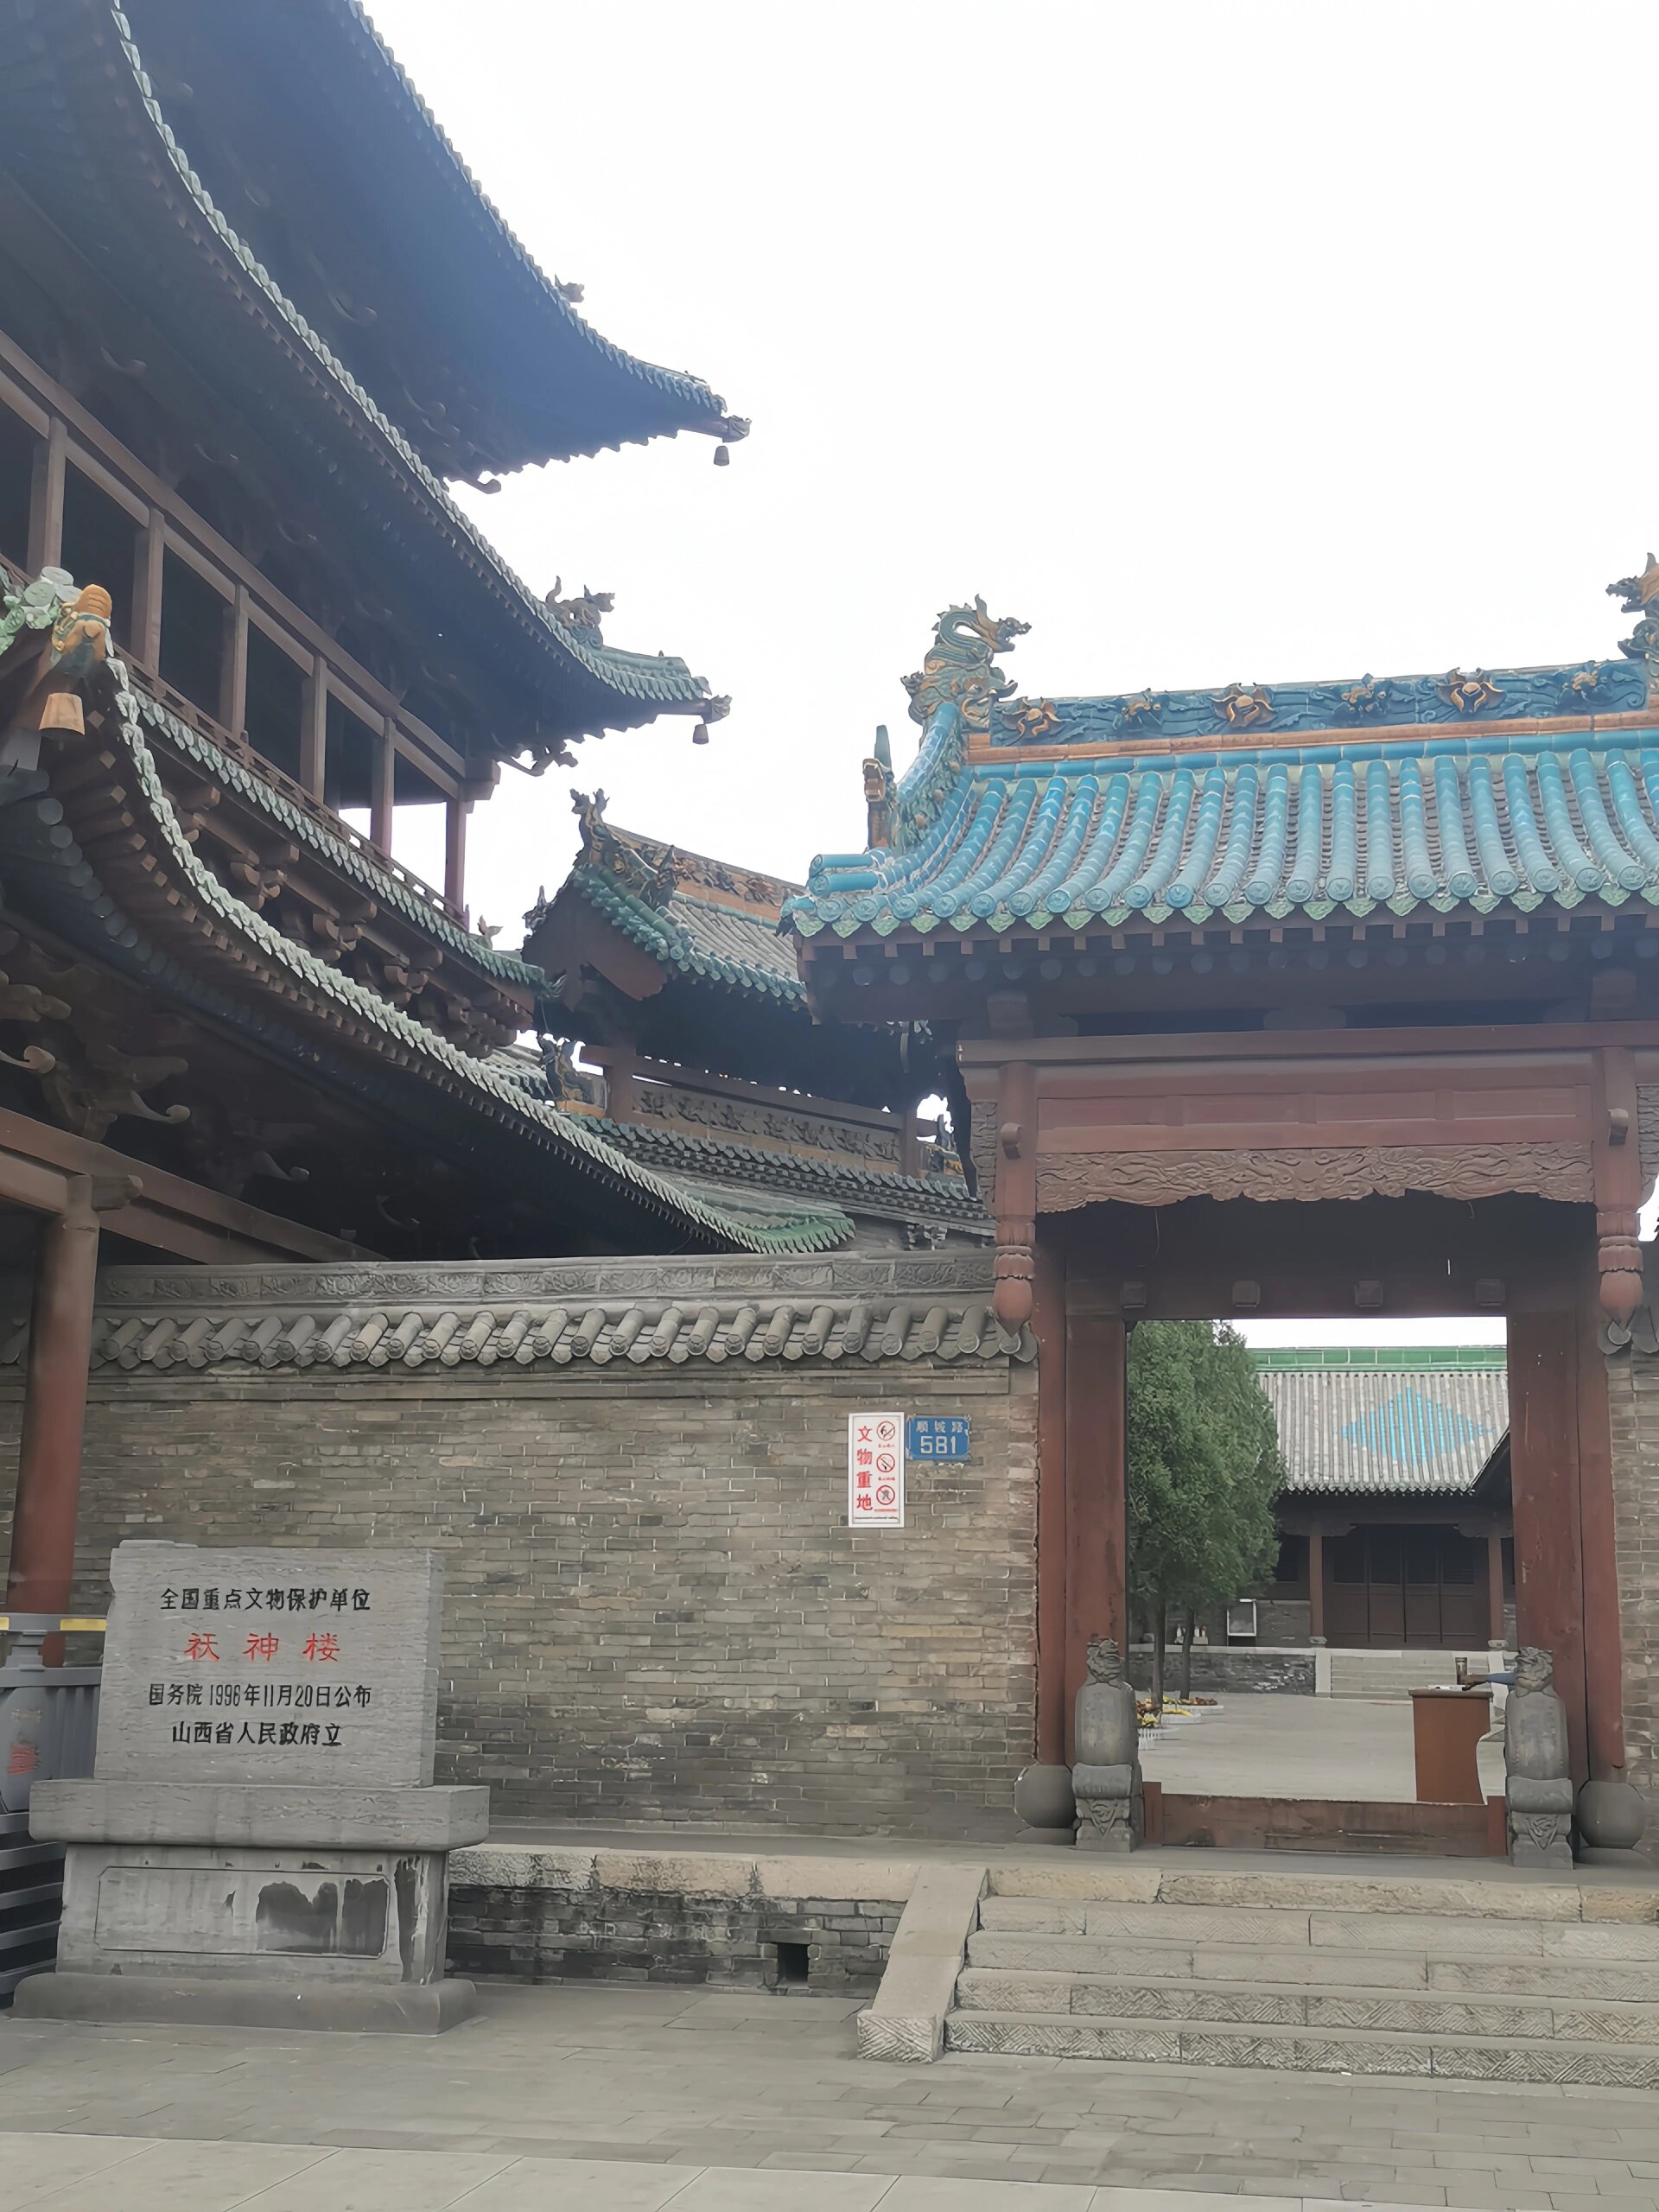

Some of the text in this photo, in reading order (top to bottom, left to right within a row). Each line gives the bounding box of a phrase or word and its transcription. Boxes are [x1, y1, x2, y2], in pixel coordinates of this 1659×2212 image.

[920, 1435, 957, 1454] 581
[856, 1425, 873, 1510] 文物重地
[160, 1587, 372, 1611] 全国重点文物保护单位
[183, 1631, 341, 1662] 祆神楼
[172, 1720, 344, 1747] 山西省人民政府立
